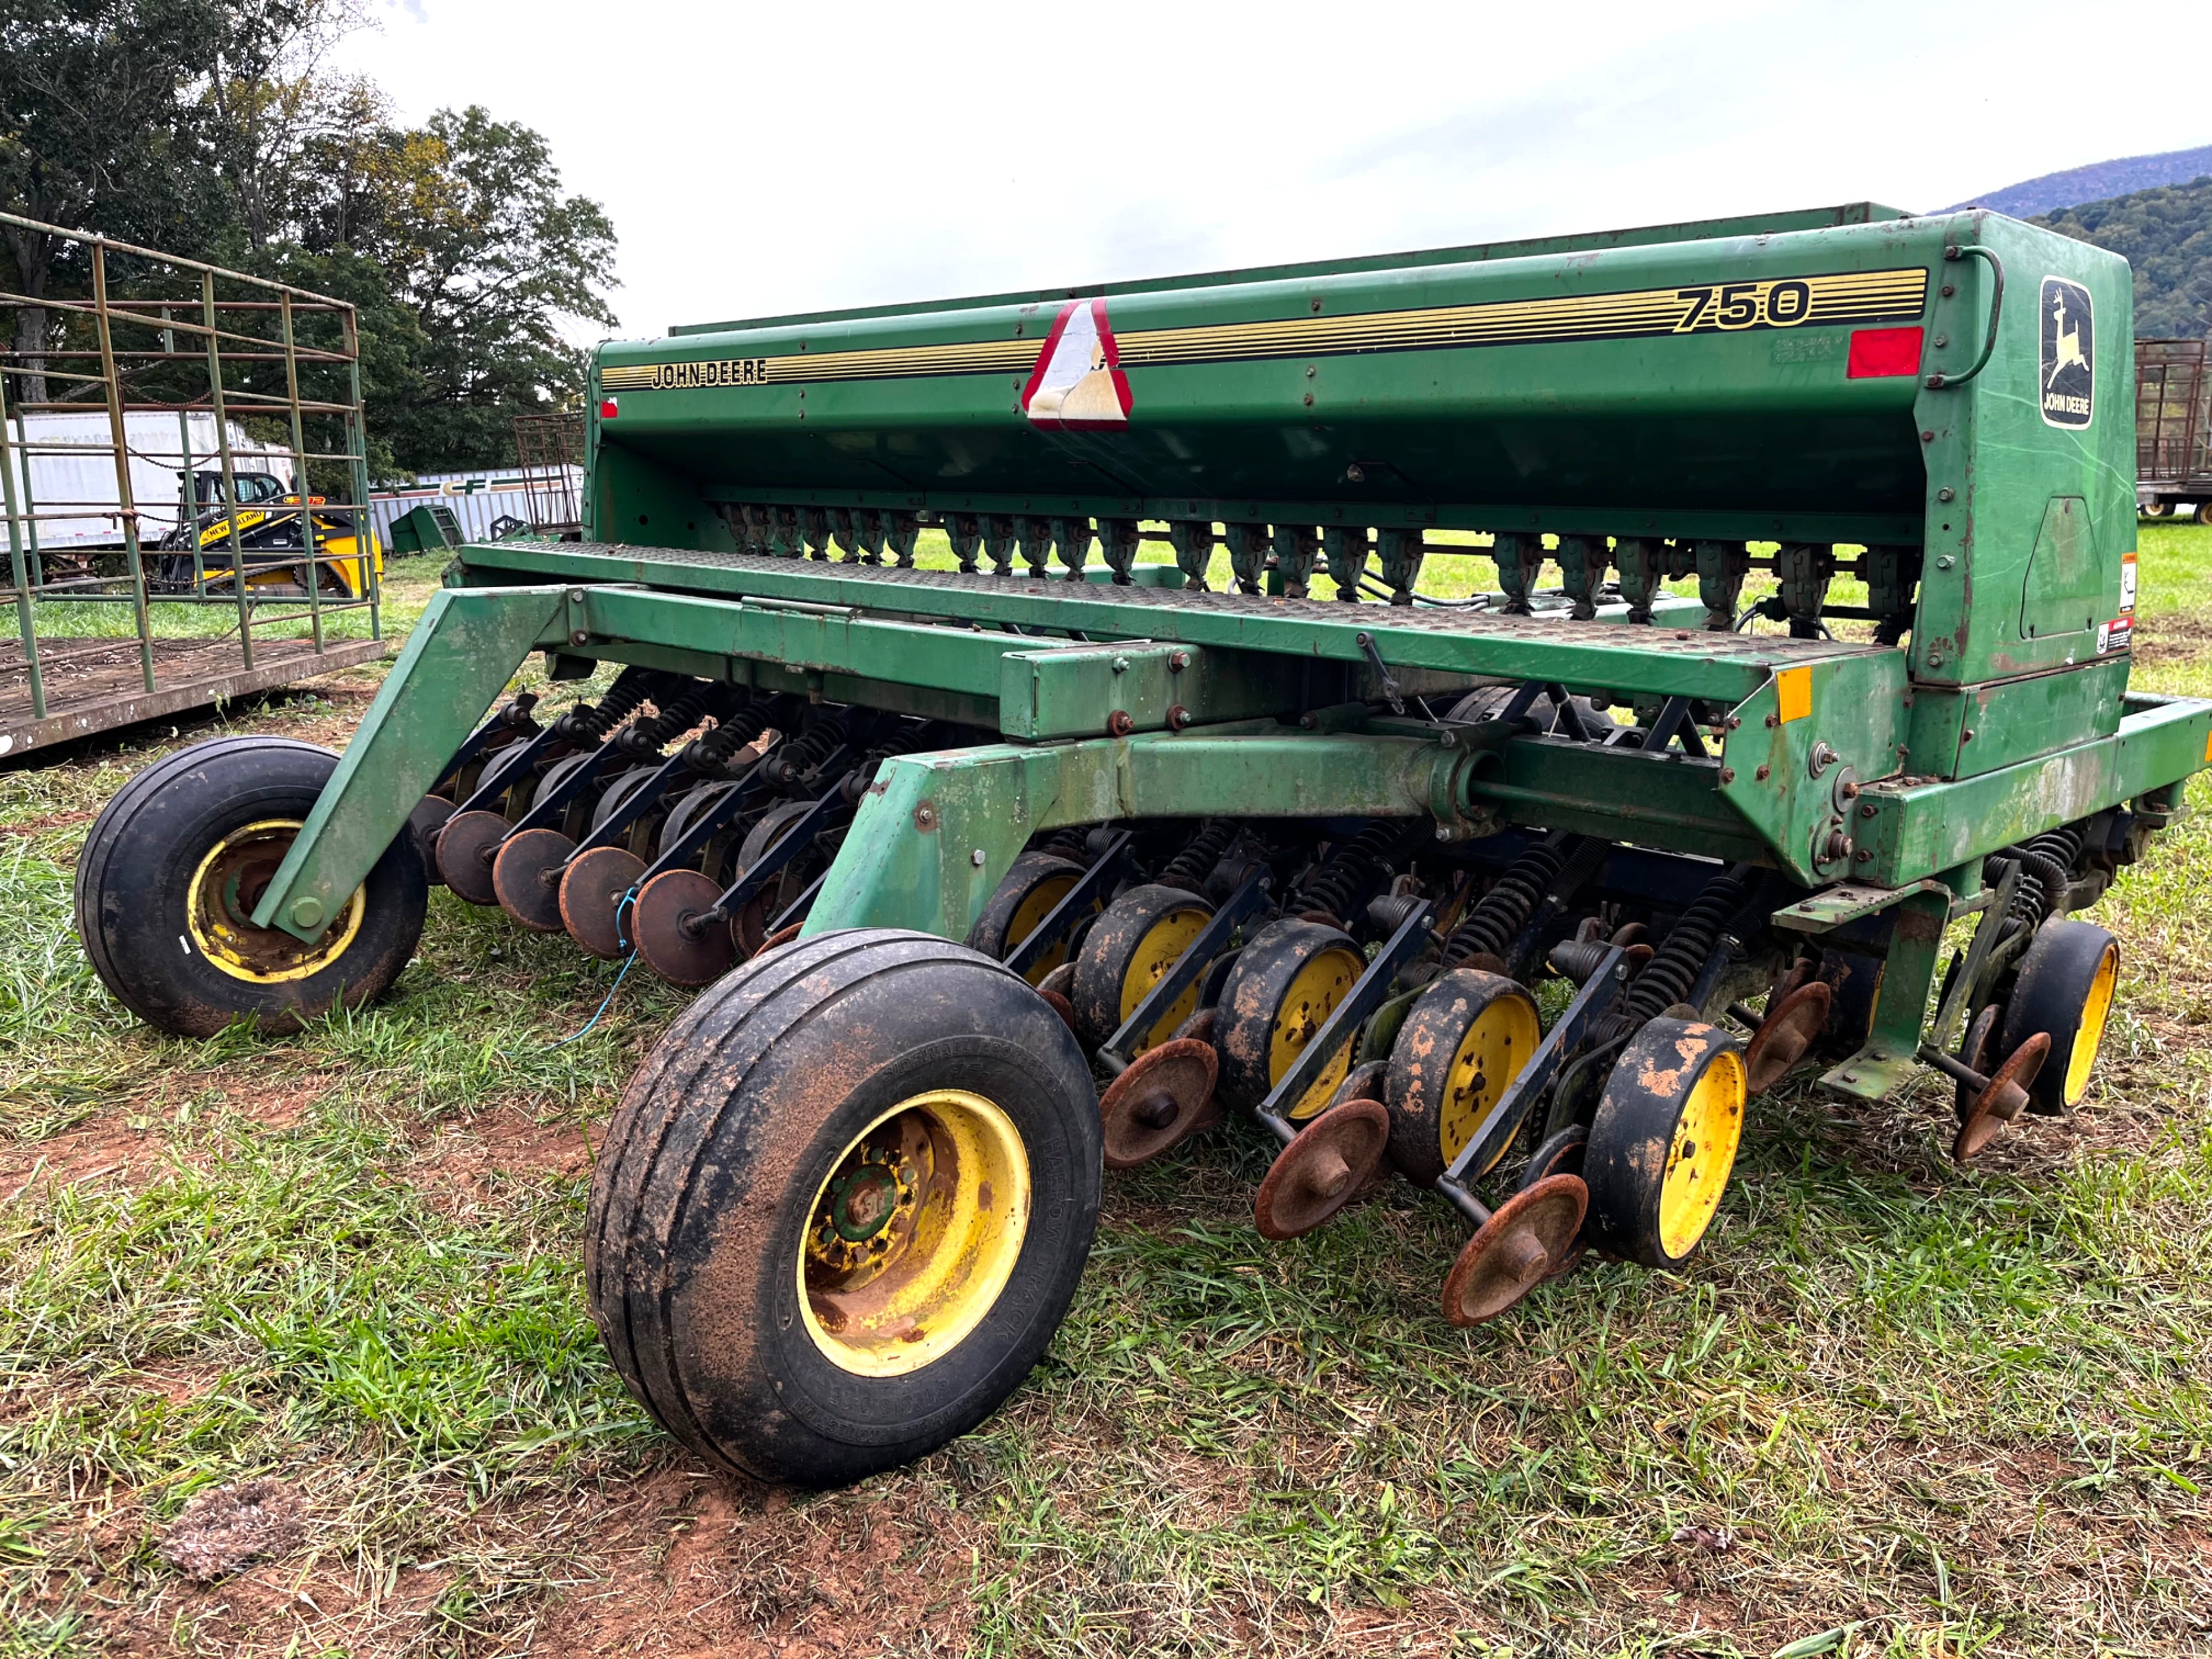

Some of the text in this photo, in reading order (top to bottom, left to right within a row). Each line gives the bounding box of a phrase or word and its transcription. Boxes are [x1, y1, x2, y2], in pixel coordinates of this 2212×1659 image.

[1673, 279, 1812, 333] 750
[651, 359, 767, 389] JOHN DEERE
[2044, 393, 2089, 415] JOHN DEERE
[210, 525, 227, 536] NEW
[881, 1039, 972, 1082] SIDEWALL
[978, 1037, 1068, 1097] PROTECTION
[996, 1134, 1066, 1342] HARROW TRACK
